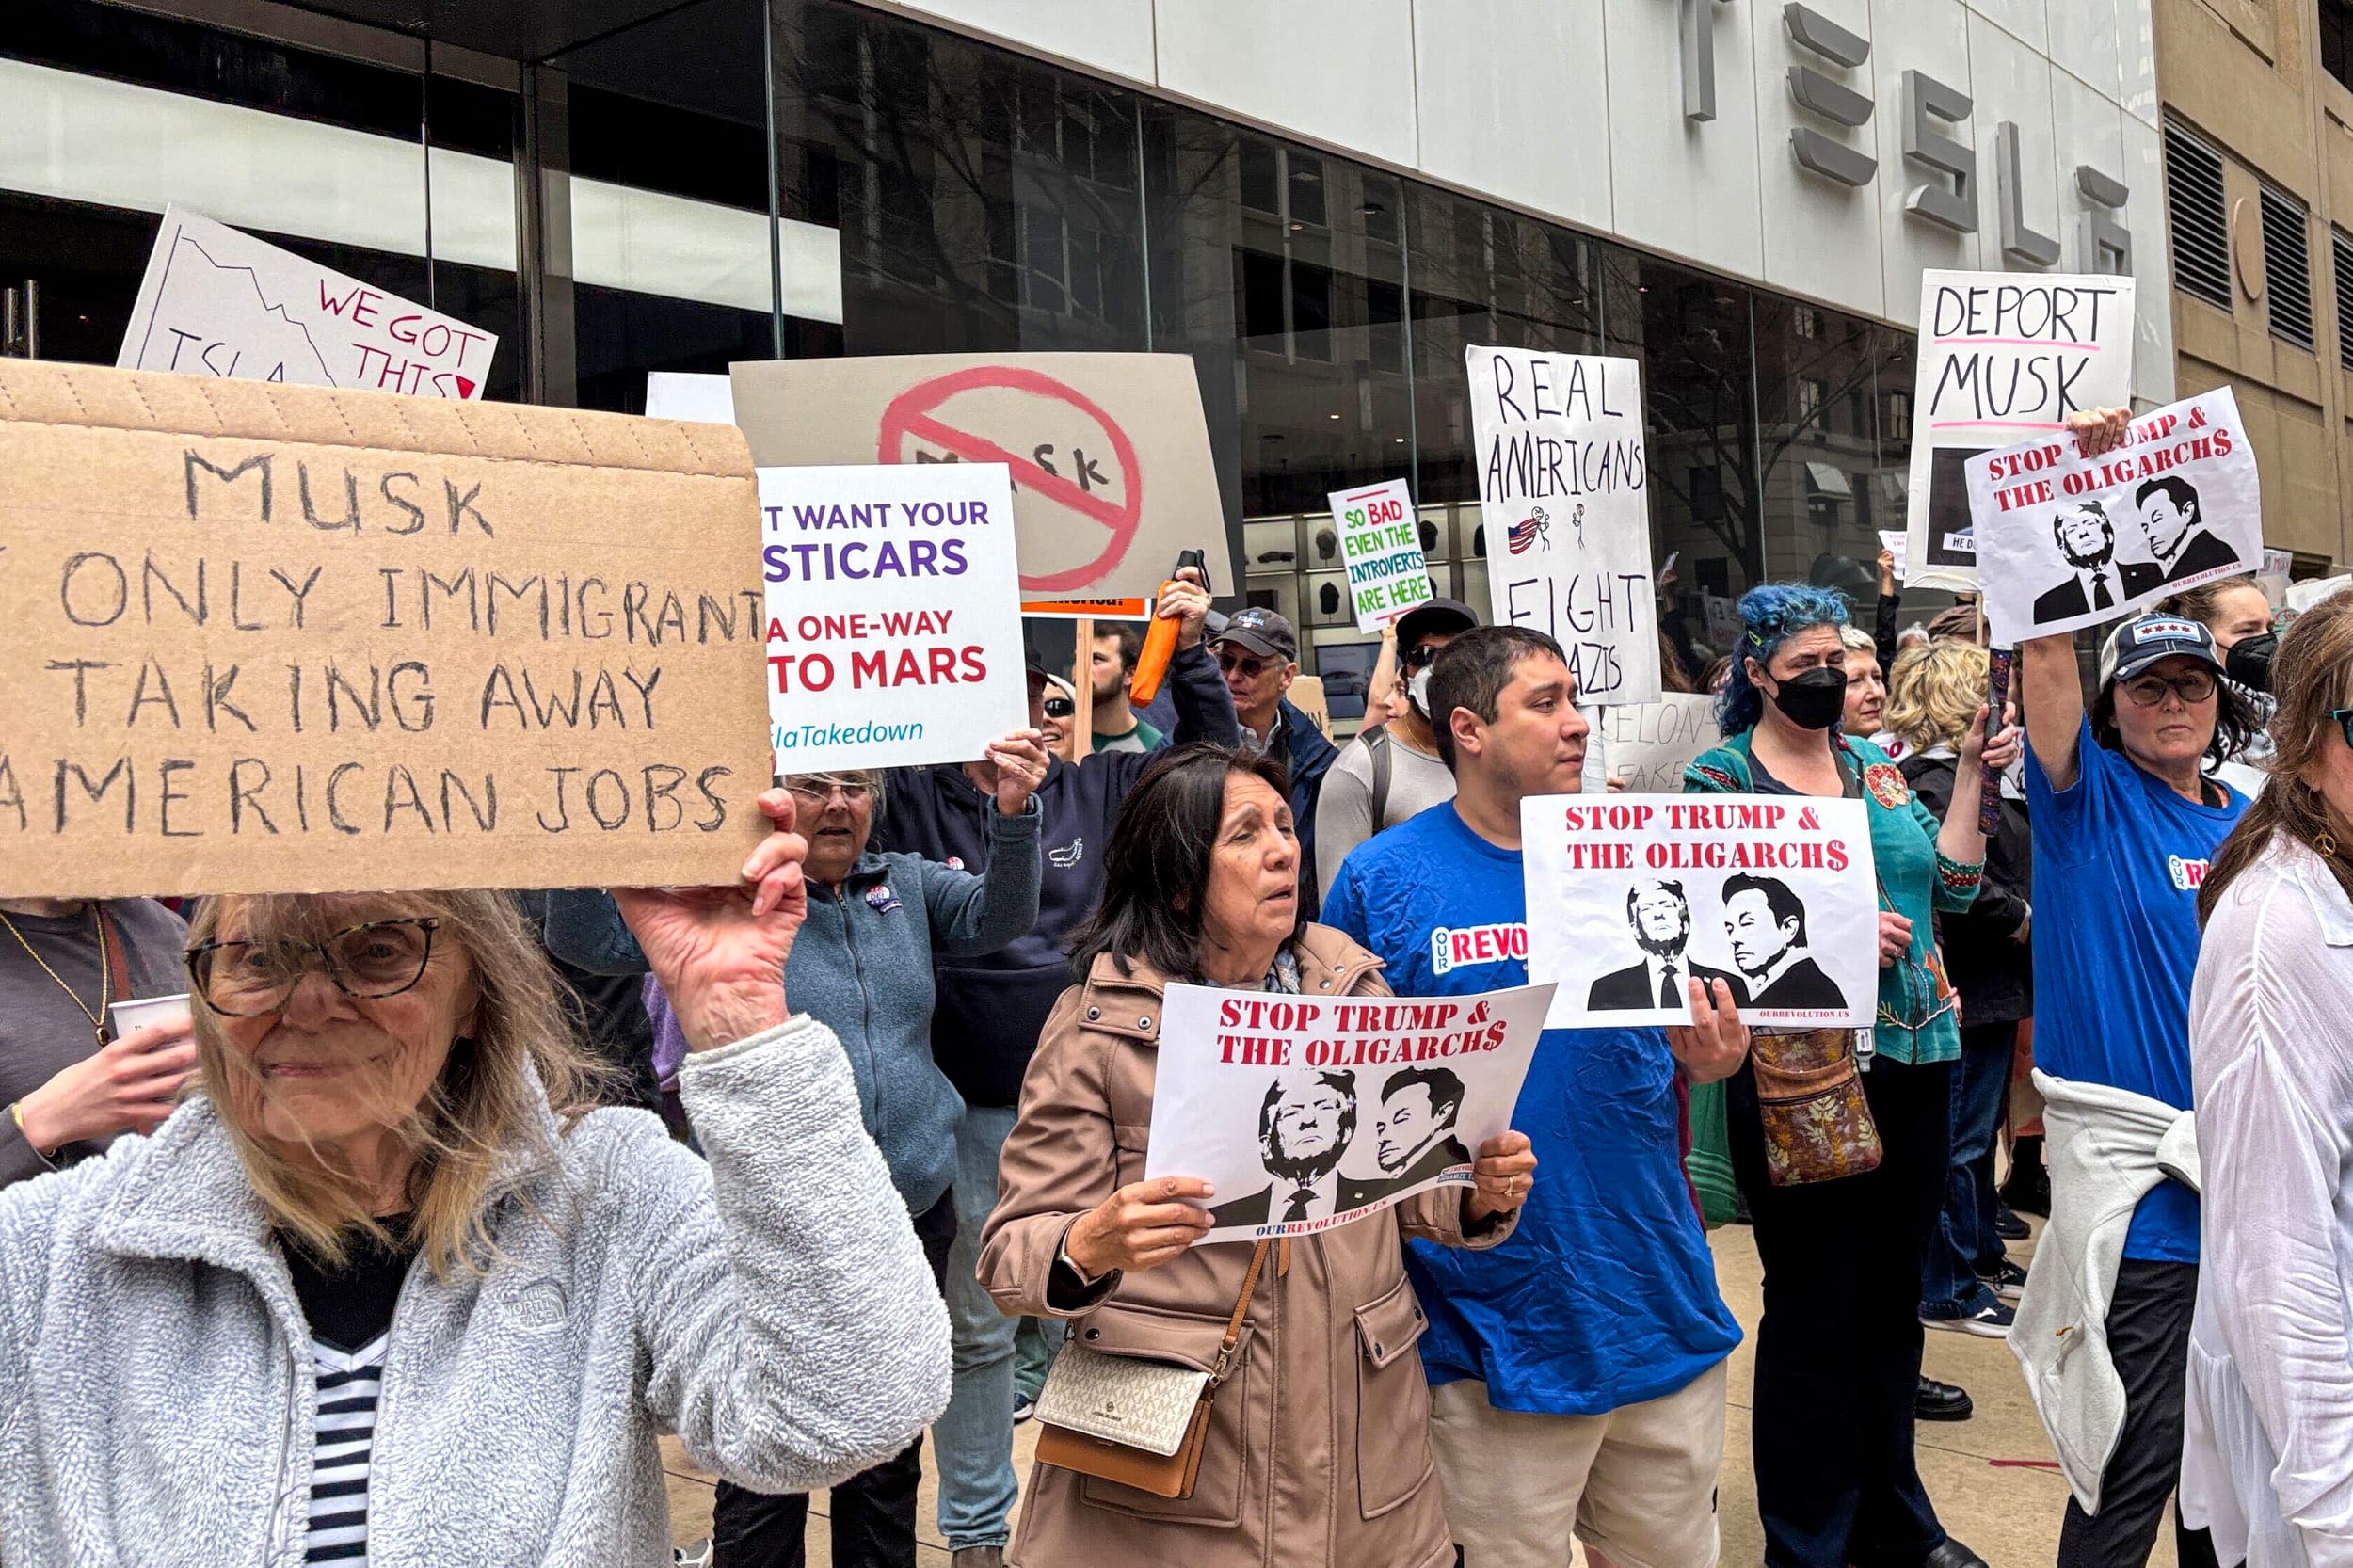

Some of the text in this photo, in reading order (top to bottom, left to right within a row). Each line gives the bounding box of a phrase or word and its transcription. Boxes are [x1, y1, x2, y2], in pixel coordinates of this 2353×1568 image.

[320, 279, 488, 368] WE GOT
[1934, 285, 2117, 343] DEPORT
[351, 343, 454, 399] THIS
[1494, 354, 1624, 424] REAL
[1929, 353, 2089, 423] MUSK
[1989, 406, 2209, 481] STOP UMP &
[1487, 430, 1643, 504] AMERICANS
[1993, 428, 2233, 512] THE OLIGARCH$
[182, 448, 496, 539] MUSK
[792, 502, 892, 531] WANT
[900, 500, 990, 528] YOUR
[1344, 500, 1403, 529] SO BAD
[762, 537, 968, 584] STICARS
[1344, 522, 1416, 557] EVEN THE
[1952, 536, 1965, 548] HE
[1348, 551, 1425, 584] INTROVERTS
[60, 548, 764, 648] ONLY IMMIGRANT
[1356, 575, 1431, 615] ARE HERE
[1508, 571, 1647, 638] FIGHT
[766, 608, 954, 643] A ONE-WAY
[768, 645, 989, 695] TO MARS
[1568, 642, 1623, 696] AZIS
[44, 653, 664, 734] TAKING AWAY
[772, 719, 924, 749] laTakedown
[536, 764, 735, 834] JOBS
[1617, 760, 1685, 792] FAKE
[1565, 804, 1822, 832] STOP TRUMP &
[1567, 839, 1850, 872] THE OLIGARCH$
[2171, 858, 2184, 887] OUR
[1435, 932, 1448, 969] OUR
[1452, 927, 1528, 963] REVO
[1220, 999, 1490, 1032] STOP TRUMP &
[1217, 1020, 1508, 1066] THE OLIGARCH$
